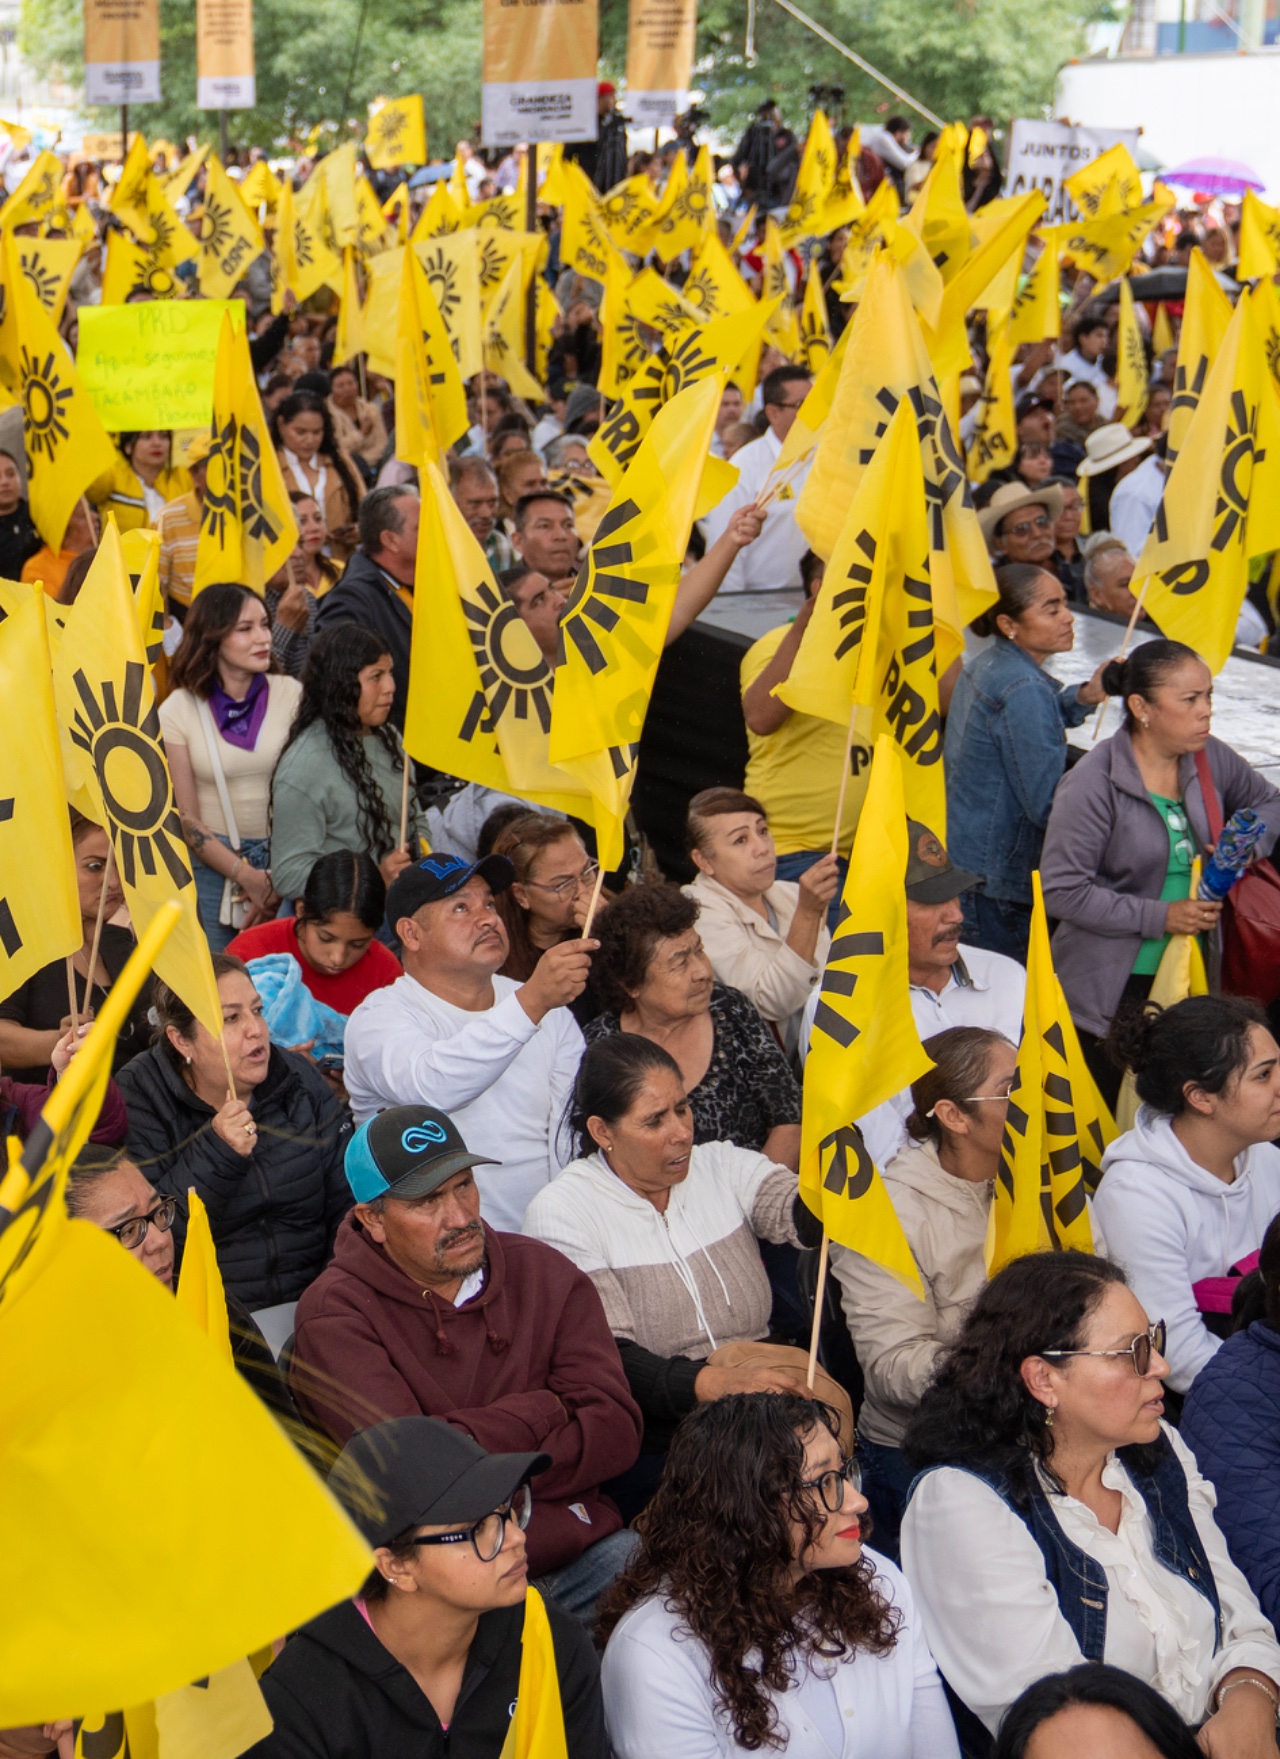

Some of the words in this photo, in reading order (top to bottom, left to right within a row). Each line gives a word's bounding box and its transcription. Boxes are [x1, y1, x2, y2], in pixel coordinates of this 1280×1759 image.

[1020, 143, 1091, 159] JUNTOS
[138, 306, 187, 336] PRD
[880, 651, 942, 766] PRD
